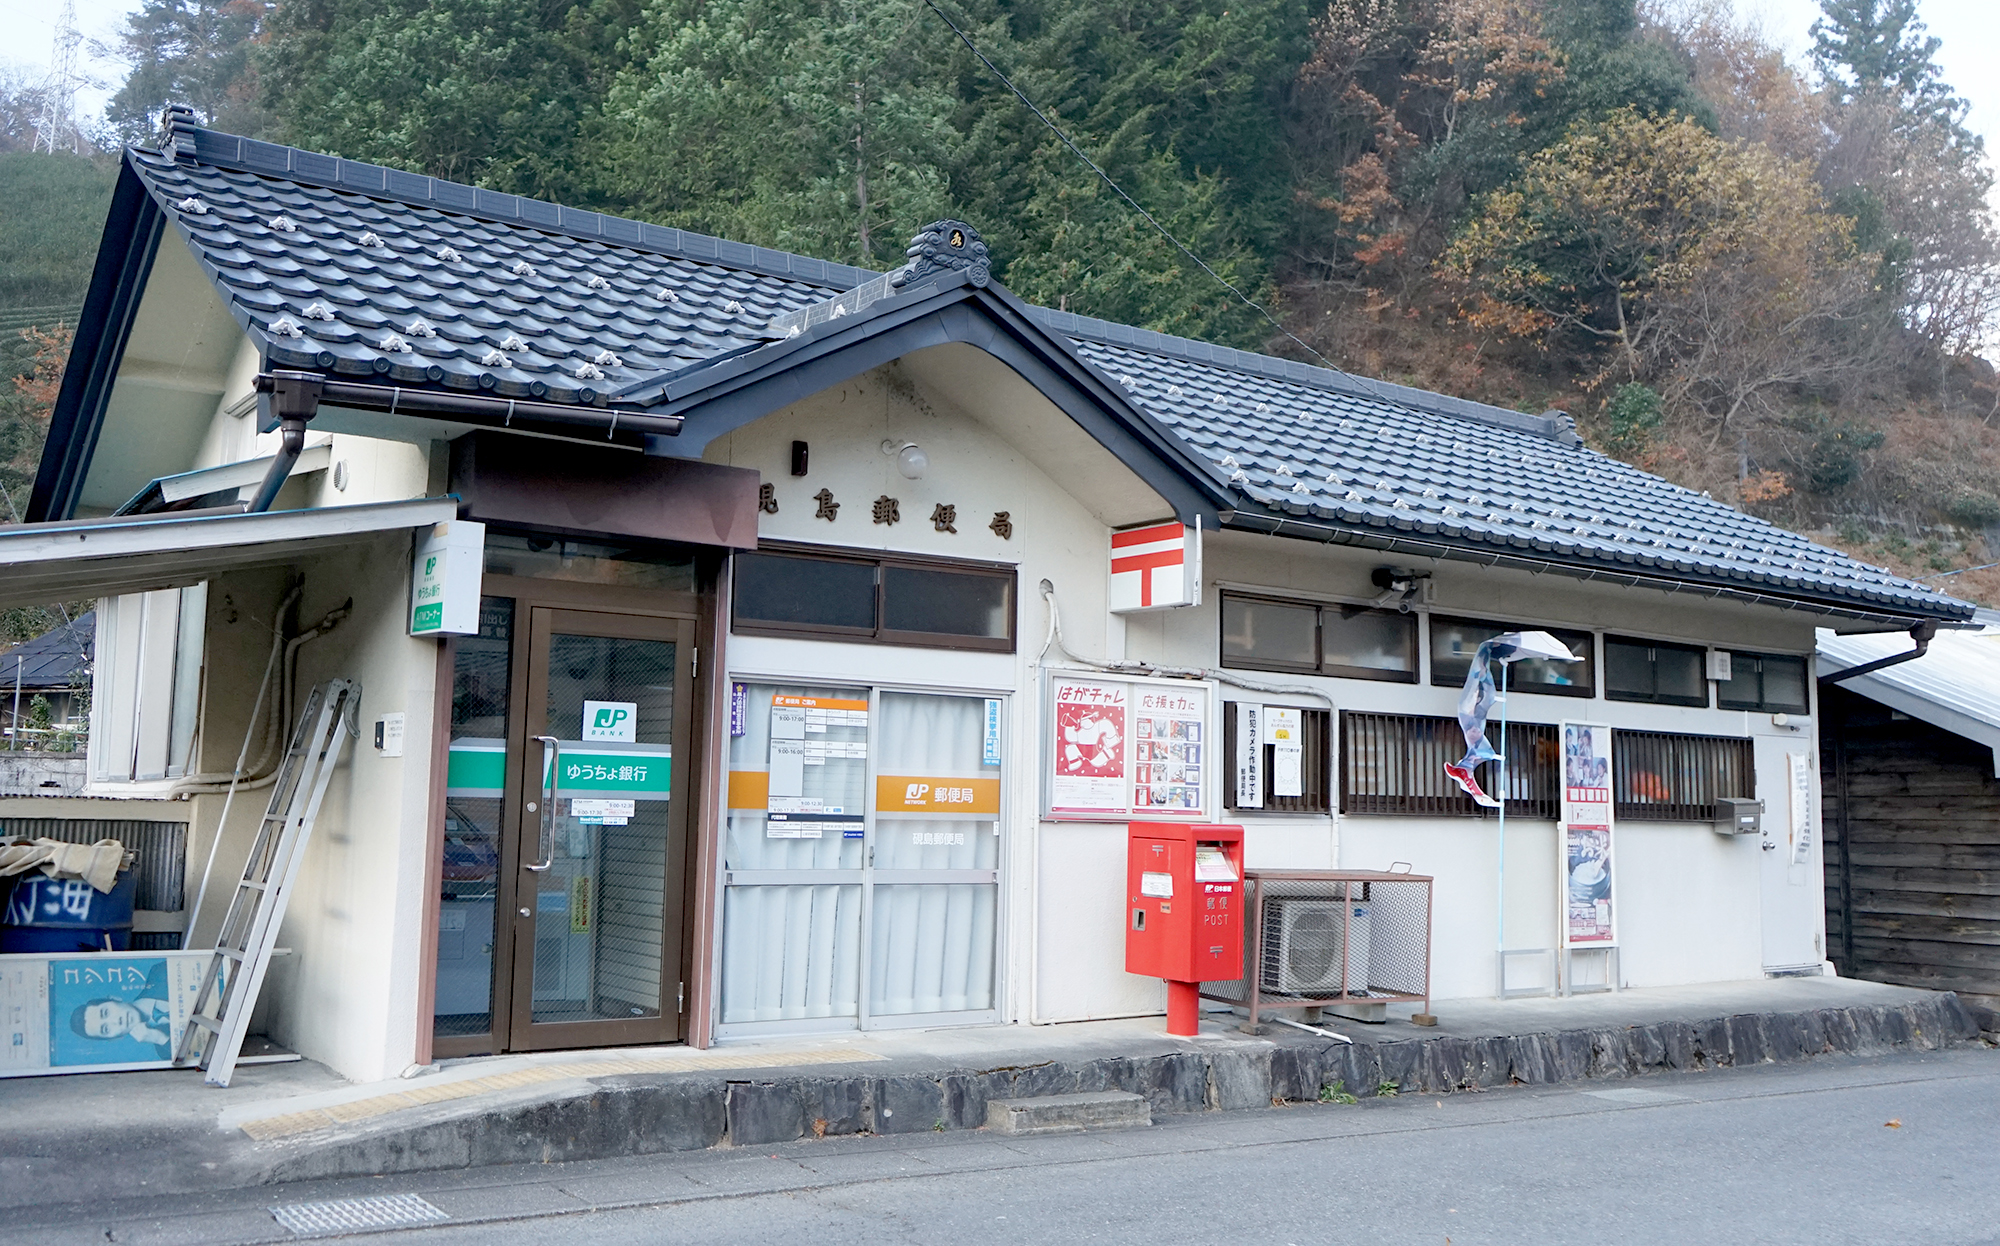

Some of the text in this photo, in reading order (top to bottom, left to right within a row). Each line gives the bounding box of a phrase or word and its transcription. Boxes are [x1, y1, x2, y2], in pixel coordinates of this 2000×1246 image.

[417, 583, 441, 599] ゆうちょ銀行
[1057, 685, 1124, 703] はがチャレ
[1142, 694, 1195, 711] 応援を力に
[593, 708, 628, 729] JP
[591, 729, 624, 737] BANK
[1248, 709, 1256, 802] 防犯カメラ作動中です
[567, 764, 648, 782] ゆうちょ銀行
[934, 787, 974, 804] 郵便局
[912, 832, 965, 846] 硯島郵便局
[1206, 896, 1228, 910] 郵便
[1204, 914, 1229, 926] POST
[63, 965, 147, 985] コツコツ
